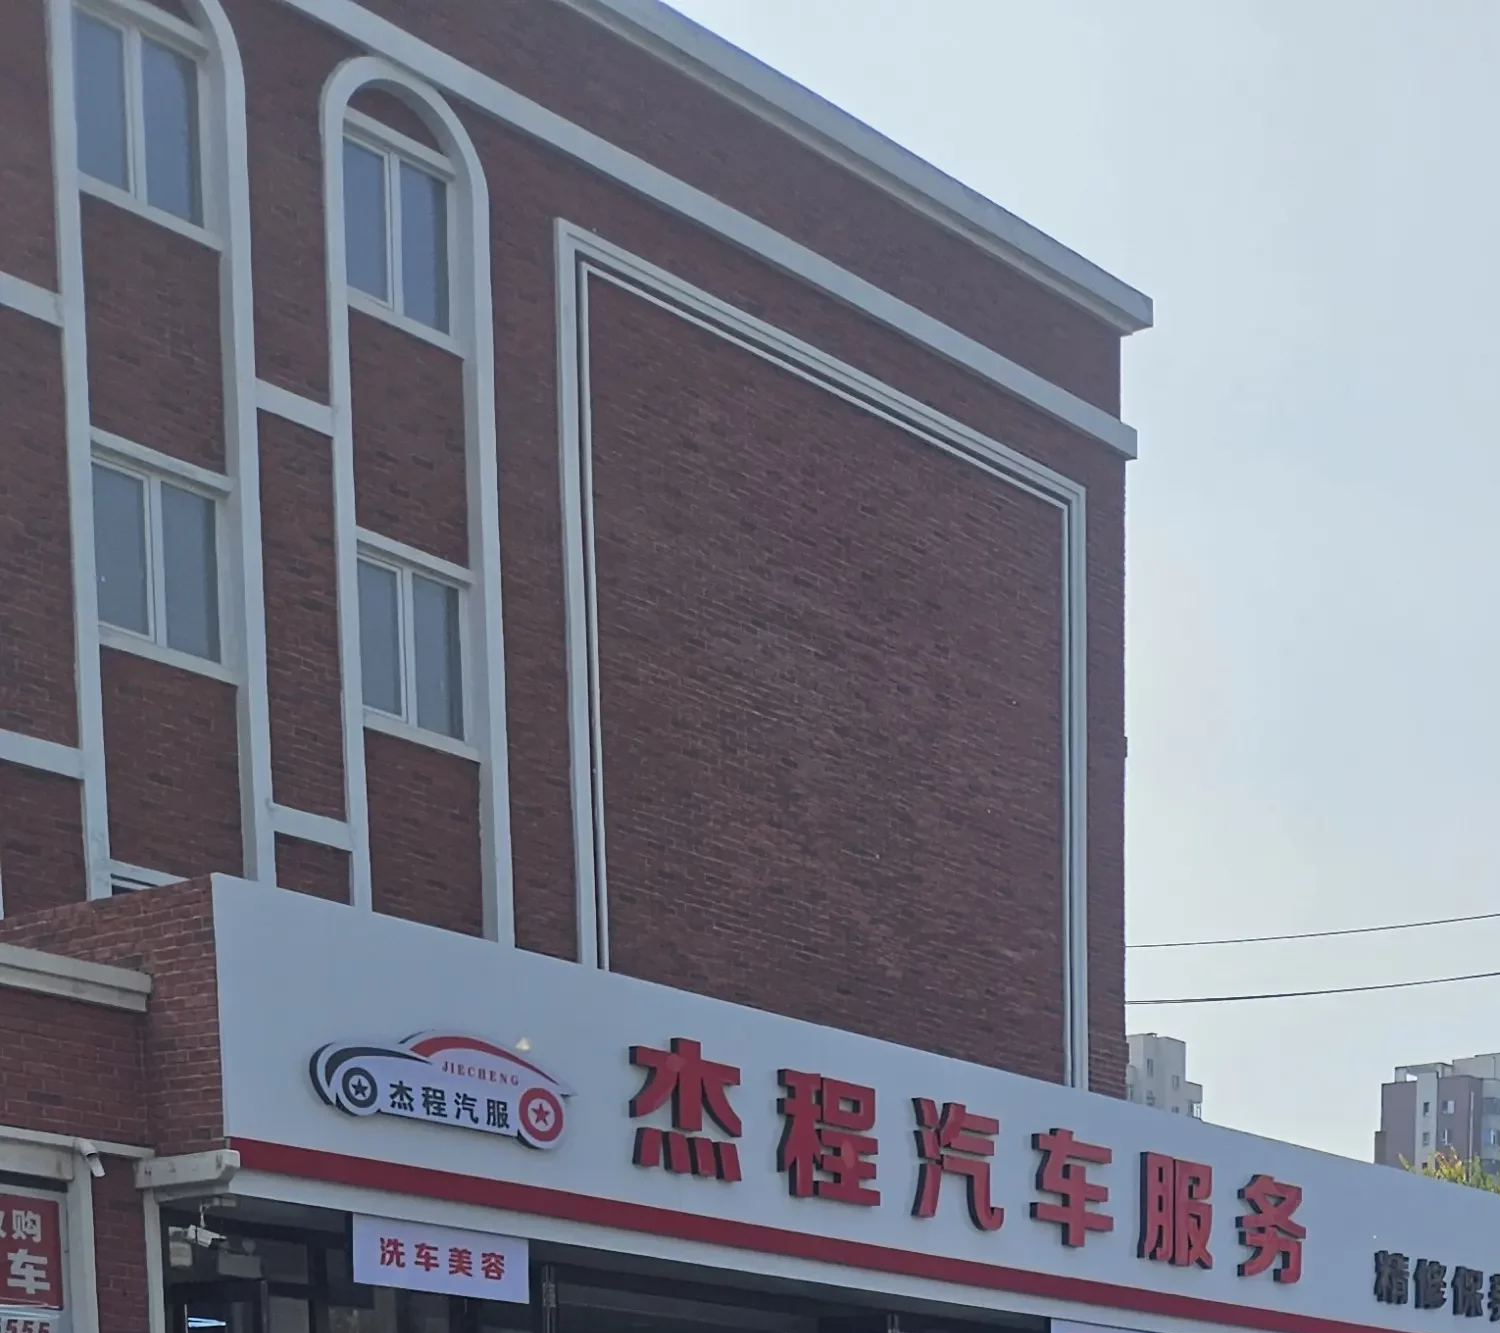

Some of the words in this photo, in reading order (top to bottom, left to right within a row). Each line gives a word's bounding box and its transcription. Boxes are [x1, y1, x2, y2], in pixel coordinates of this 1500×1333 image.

[442, 1061, 519, 1086] JIECHENG
[389, 1080, 510, 1129] 杰程汽服
[629, 1037, 1306, 1284] 杰程汽车服务
[7, 1249, 50, 1295] 车
[380, 1237, 505, 1280] 洗车美容
